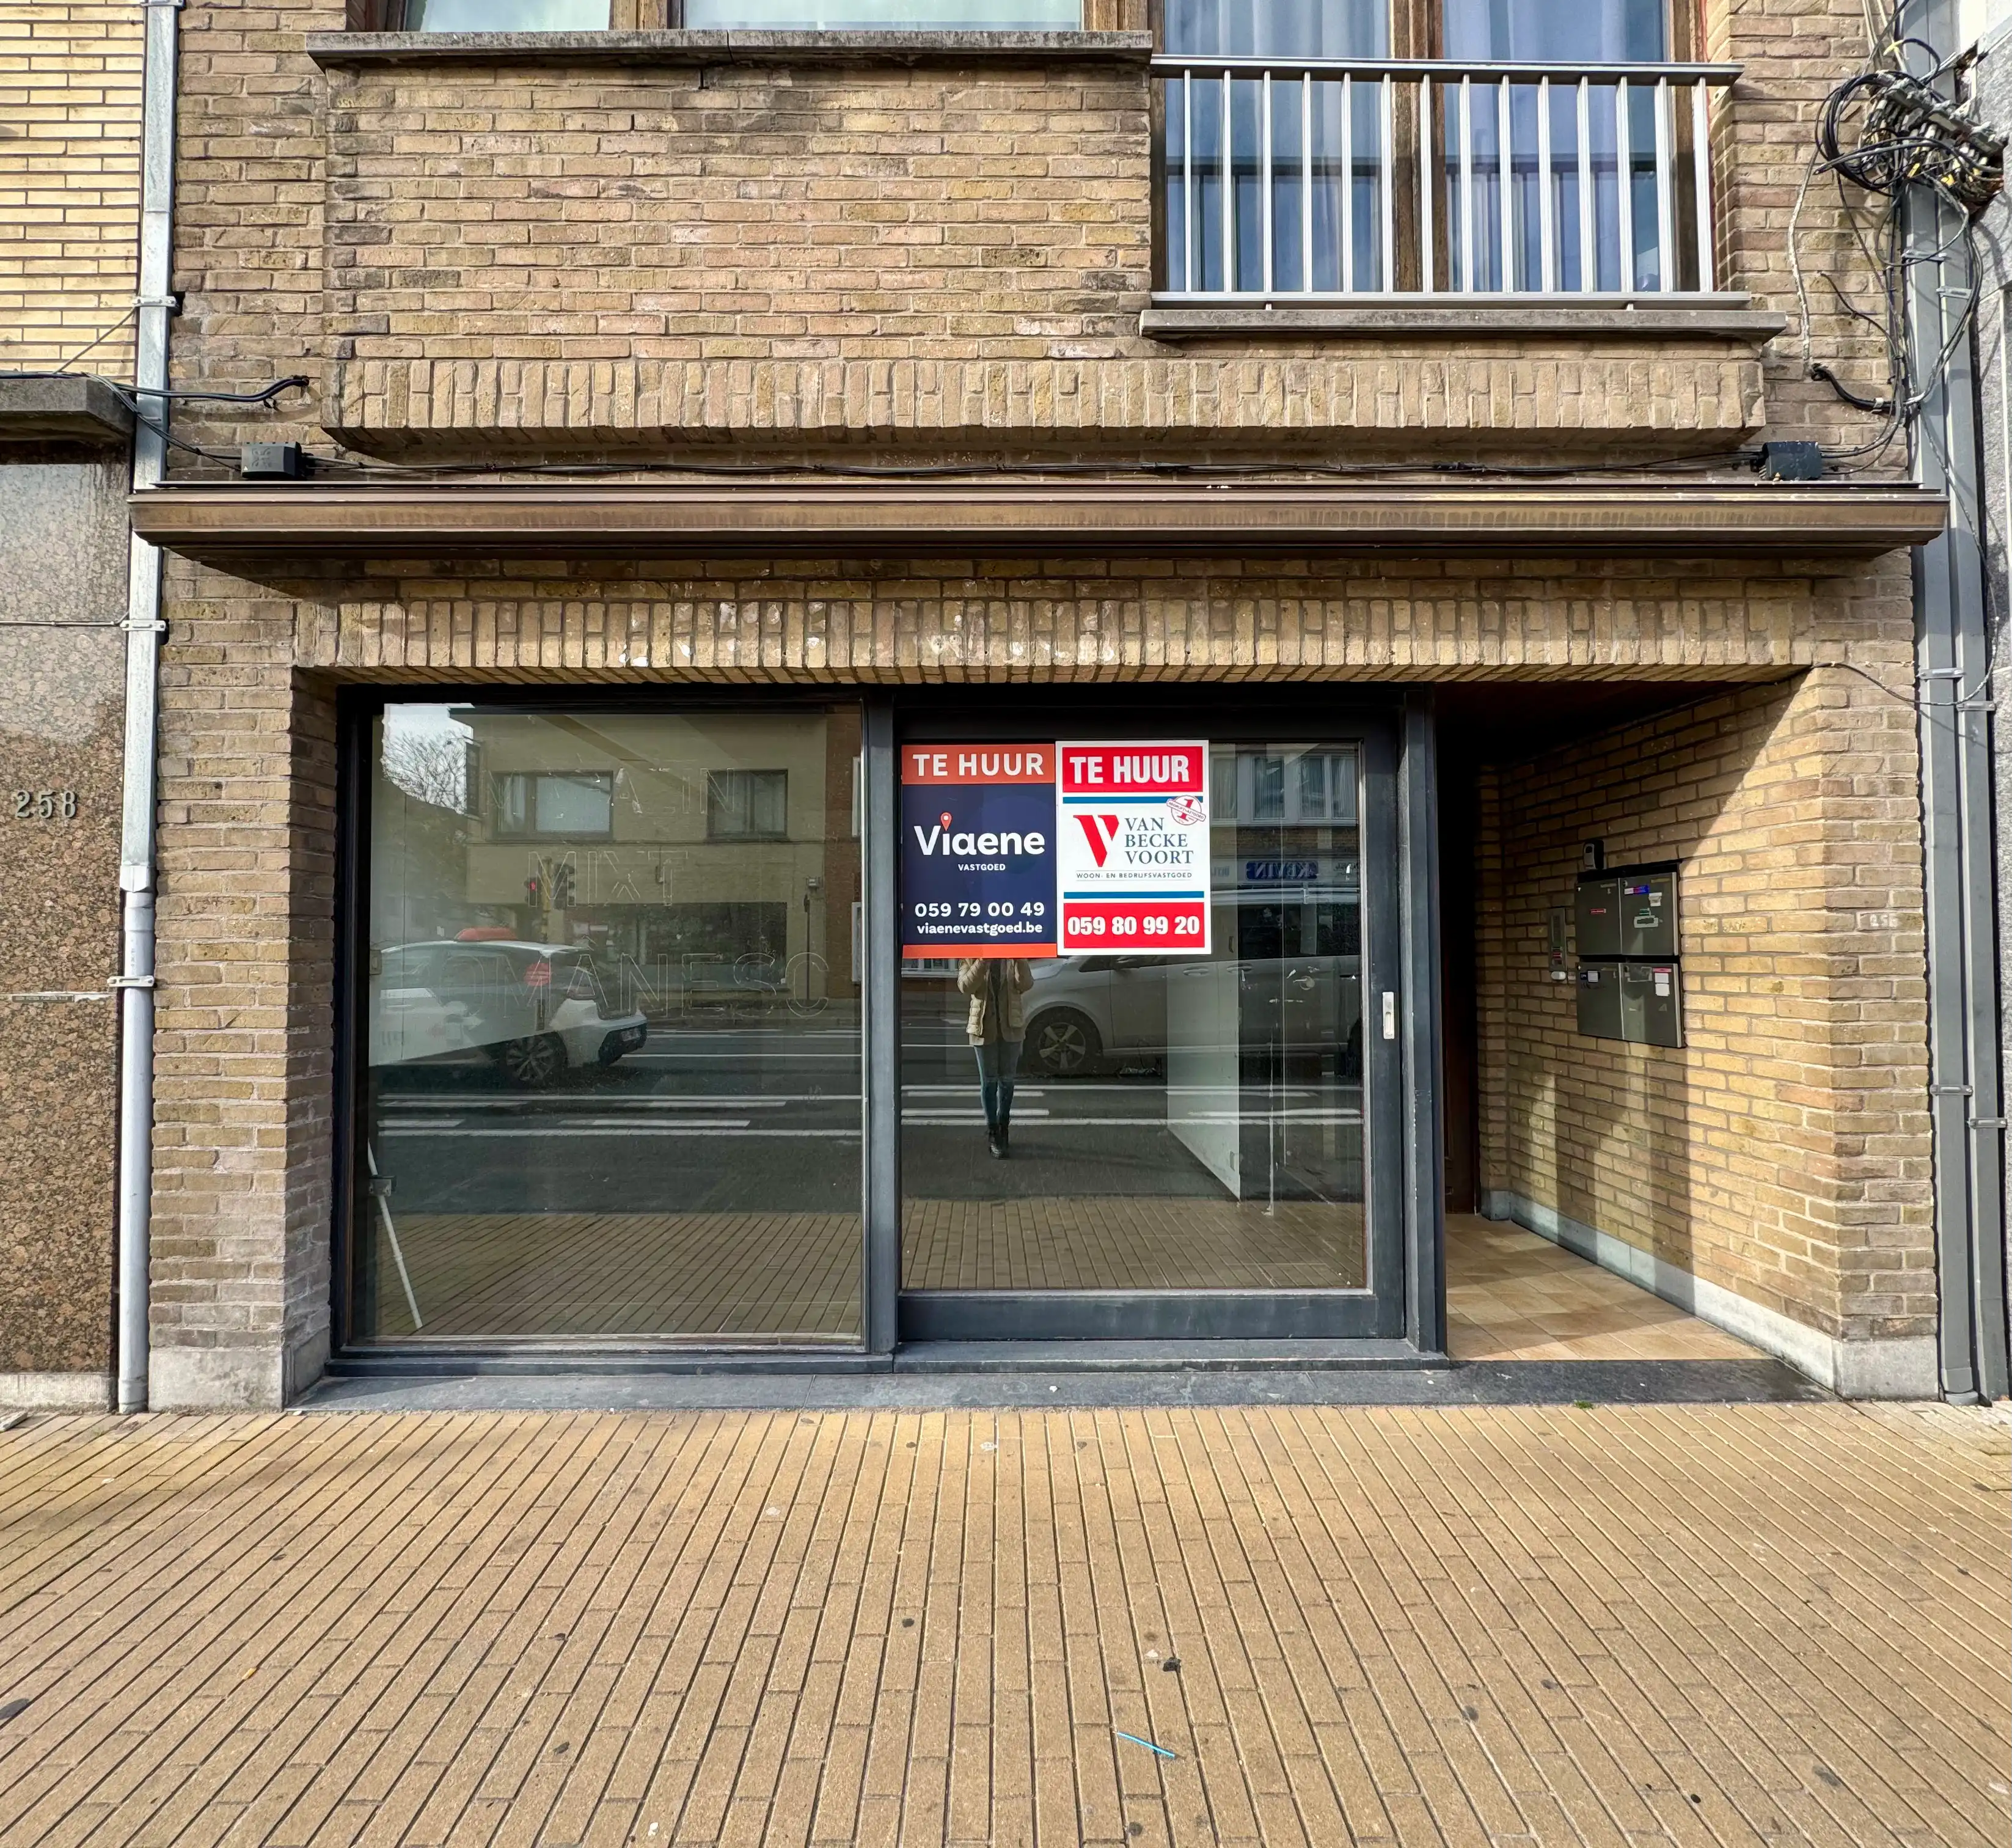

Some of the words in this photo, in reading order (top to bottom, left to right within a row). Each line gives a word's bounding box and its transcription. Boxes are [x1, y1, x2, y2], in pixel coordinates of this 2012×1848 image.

[913, 754, 948, 776] TE
[959, 753, 1044, 776] HUUR
[1070, 757, 1103, 784] TE
[1114, 755, 1190, 783] HUUR
[15, 790, 77, 819] 258
[1124, 817, 1164, 831] VAN
[913, 825, 1045, 856] Viaene
[1125, 834, 1188, 848] BECKE
[1125, 850, 1194, 864] VOORT
[915, 903, 951, 917] 059
[958, 903, 981, 917] 79
[988, 902, 1014, 917] 00
[1020, 902, 1045, 917] 49
[916, 921, 1043, 937] viaenevastgoed.be
[1068, 916, 1105, 936] 059
[1111, 916, 1137, 935] 80
[1143, 916, 1168, 935] 99
[1174, 915, 1200, 935] 20
